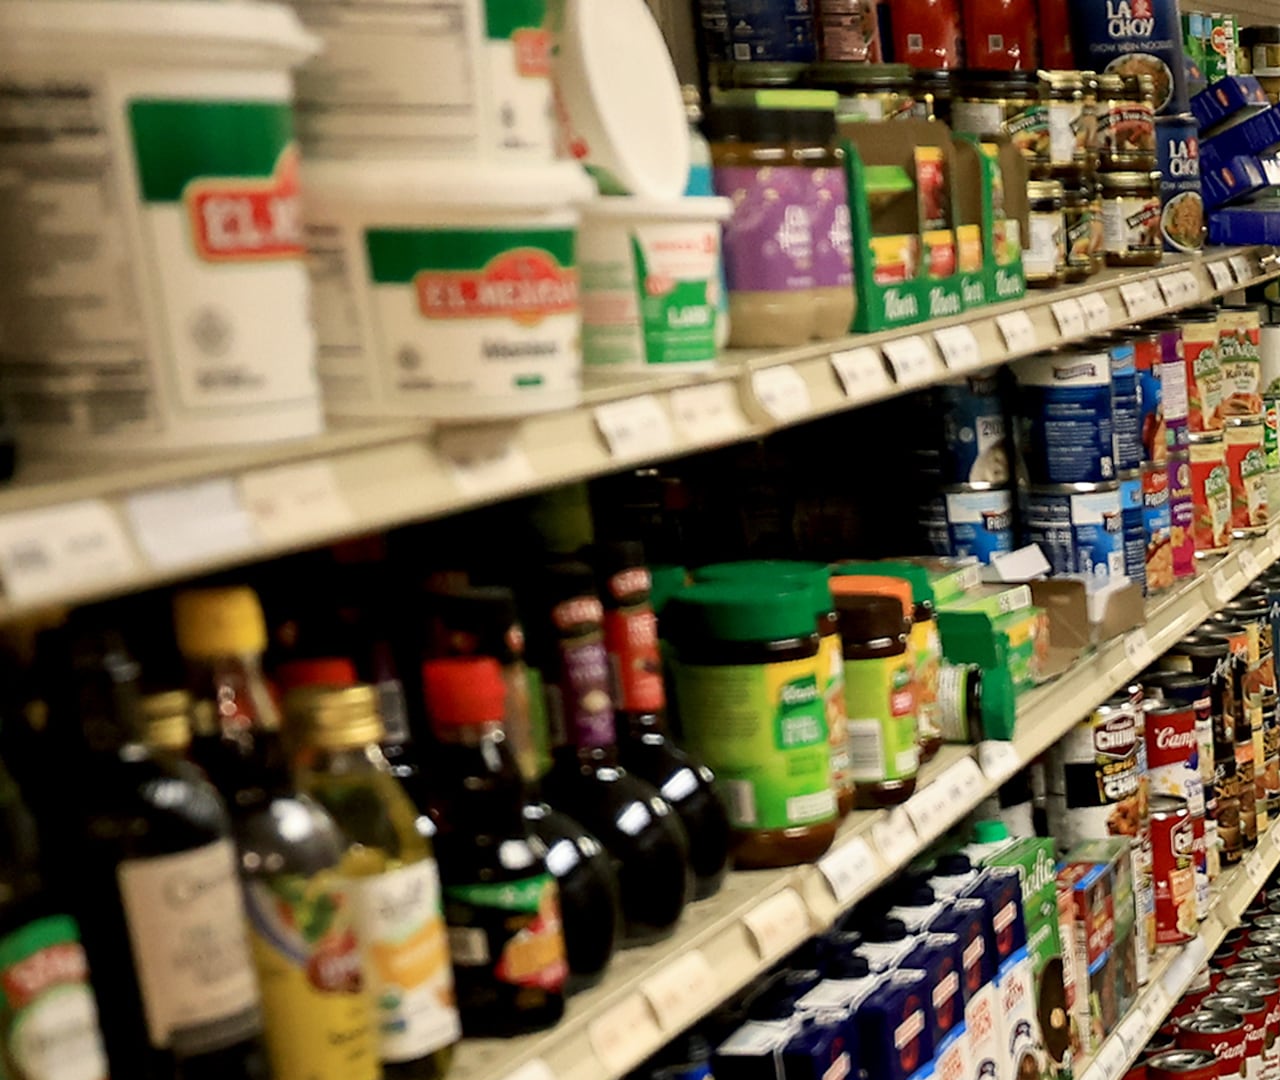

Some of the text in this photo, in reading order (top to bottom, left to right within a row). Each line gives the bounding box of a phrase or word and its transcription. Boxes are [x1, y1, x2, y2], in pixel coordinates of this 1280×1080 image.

[1107, 0, 1131, 19] LA
[1108, 17, 1154, 38] CHOY
[1169, 140, 1187, 158] LA
